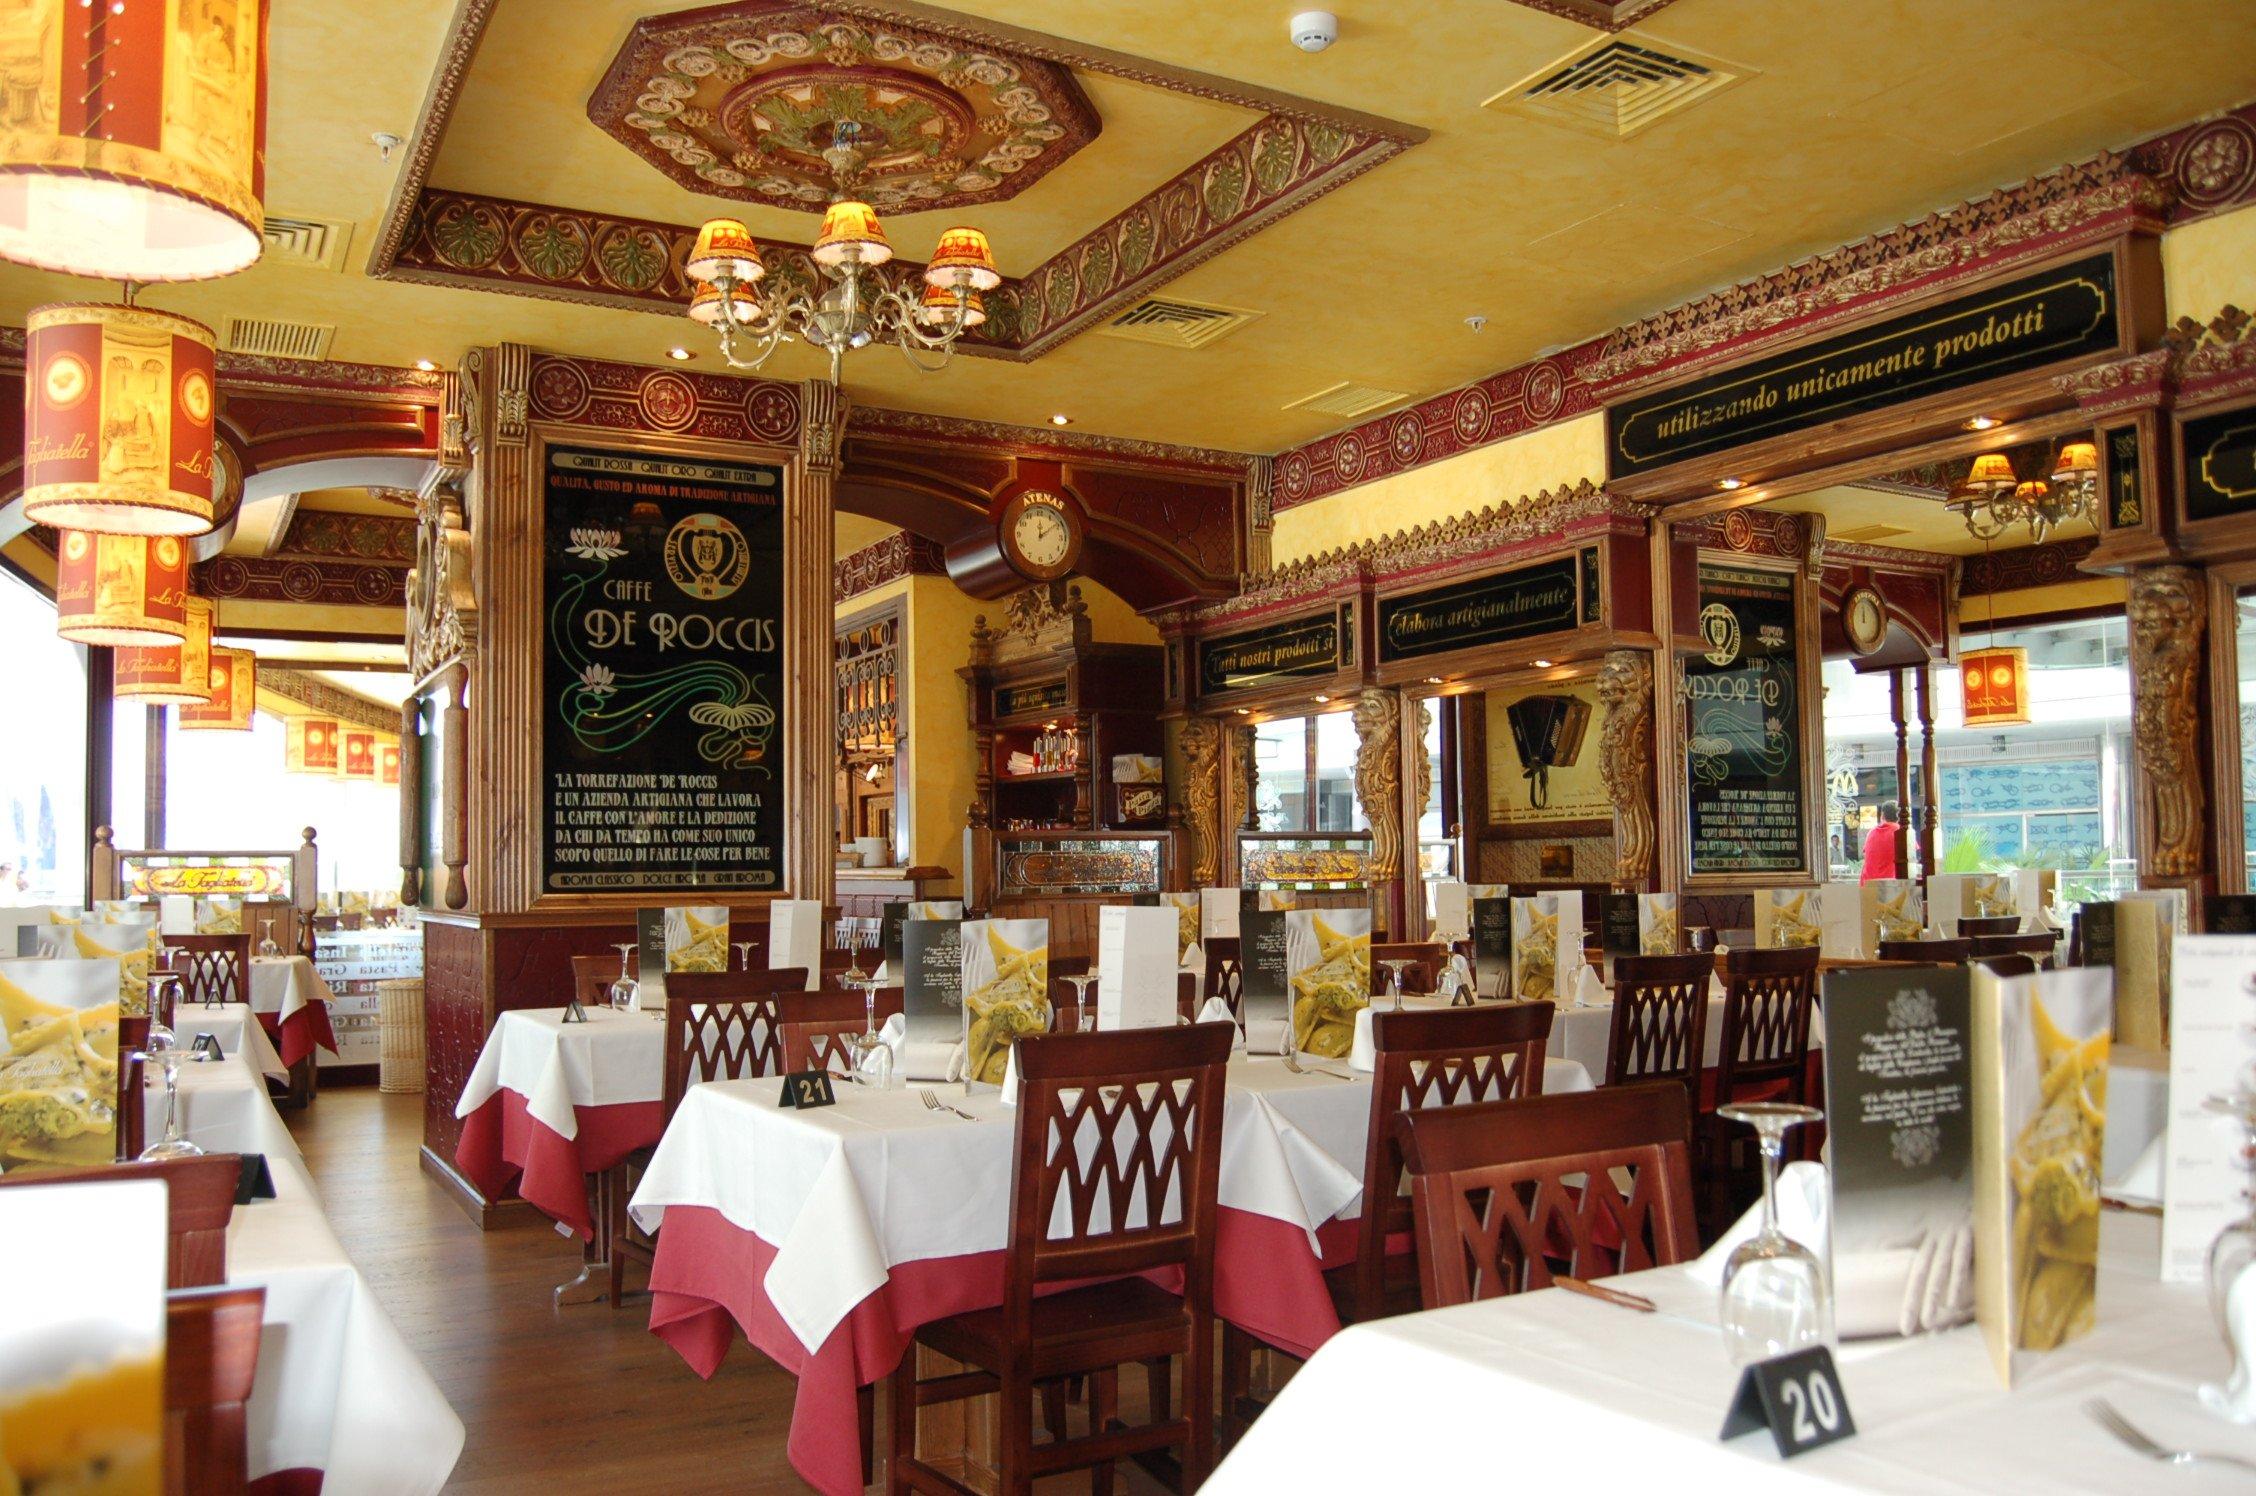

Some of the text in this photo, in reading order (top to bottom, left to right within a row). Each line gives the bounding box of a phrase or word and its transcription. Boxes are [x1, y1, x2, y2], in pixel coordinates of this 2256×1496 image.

[1656, 302, 2046, 440] utilizzando unicamente prodotti
[1023, 493, 1065, 510] ATENAS
[584, 609, 776, 653] DE ROCCIS
[1240, 645, 1271, 668] nostri
[1274, 634, 1320, 666] prodotti
[555, 773, 718, 789] LA TORREFAZIONE DE ROCCIS
[555, 792, 762, 807] E UN AZIENDA ARTIGIANA CHE LAVORA
[555, 811, 757, 825] IL CAFFE CON L'AMORE E LA DEDIZIONE
[555, 829, 755, 843] DA CHI DA TEMPO HA COME SUO UNICO
[555, 847, 771, 862] SCOPO QUELLO DI FARE LE COSE PER BENE
[799, 1077, 827, 1103] 21
[1781, 1369, 1838, 1442] 20
